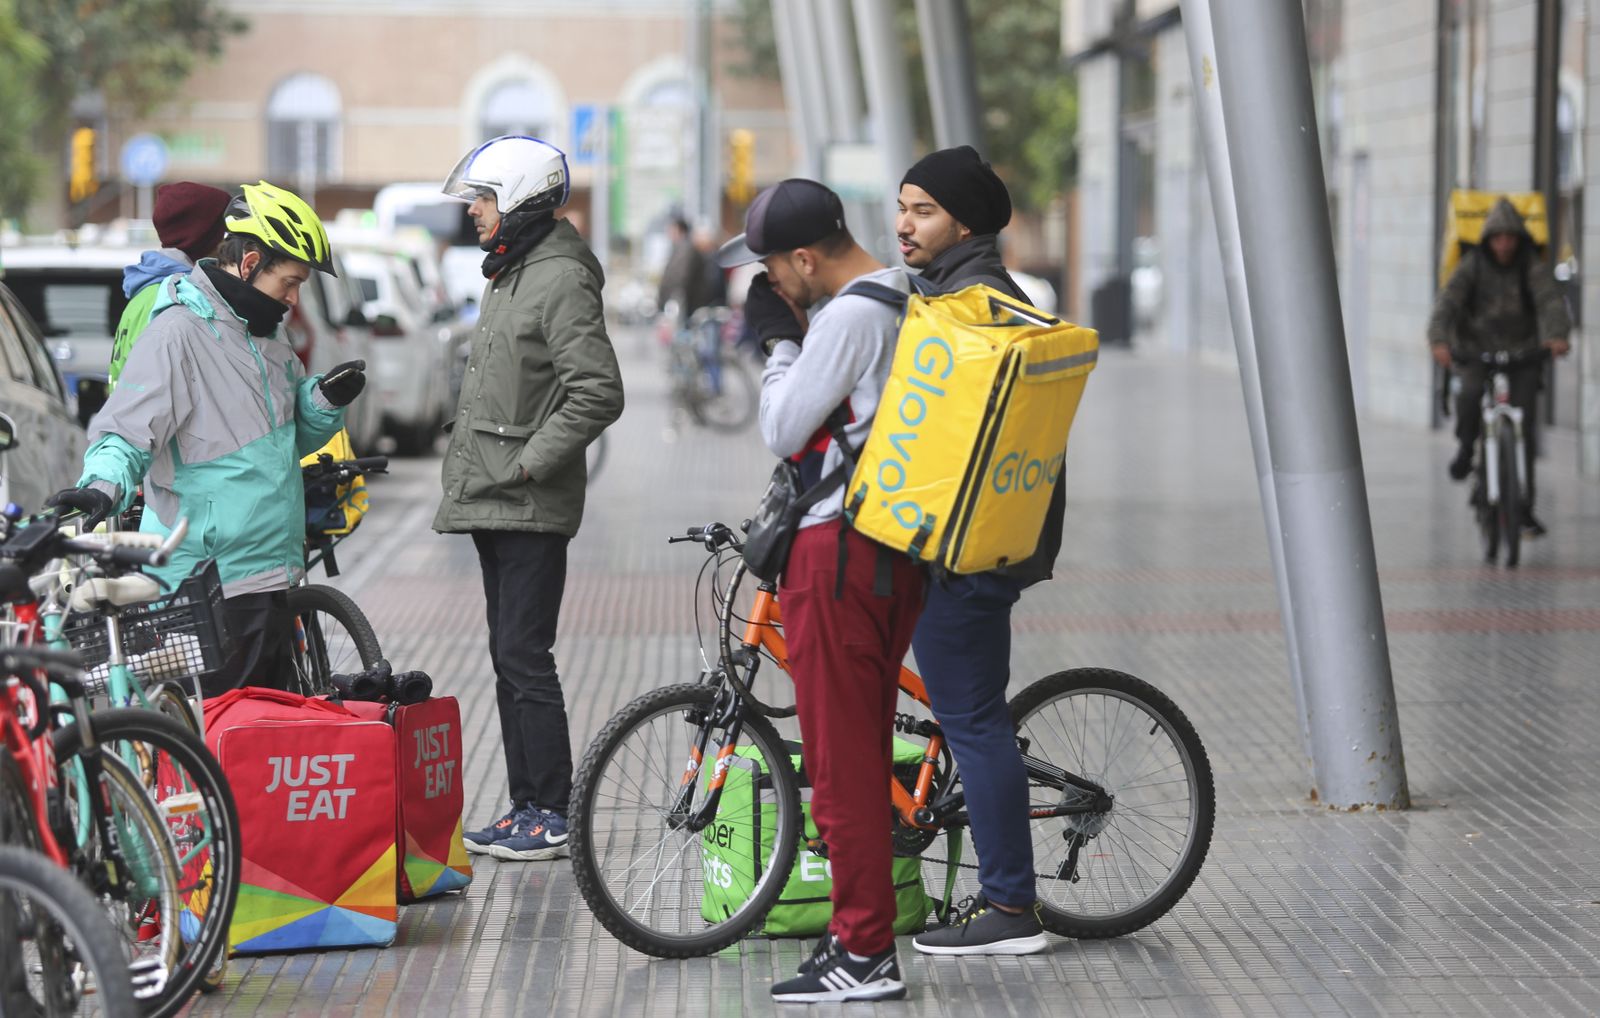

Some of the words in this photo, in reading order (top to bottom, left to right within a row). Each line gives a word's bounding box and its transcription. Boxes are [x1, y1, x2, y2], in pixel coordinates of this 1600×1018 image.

[877, 336, 954, 493] Glovo
[413, 723, 450, 768] JUST
[265, 753, 355, 793] JUST
[425, 760, 455, 800] EAT
[286, 788, 356, 822] EAT
[704, 822, 734, 849] ber
